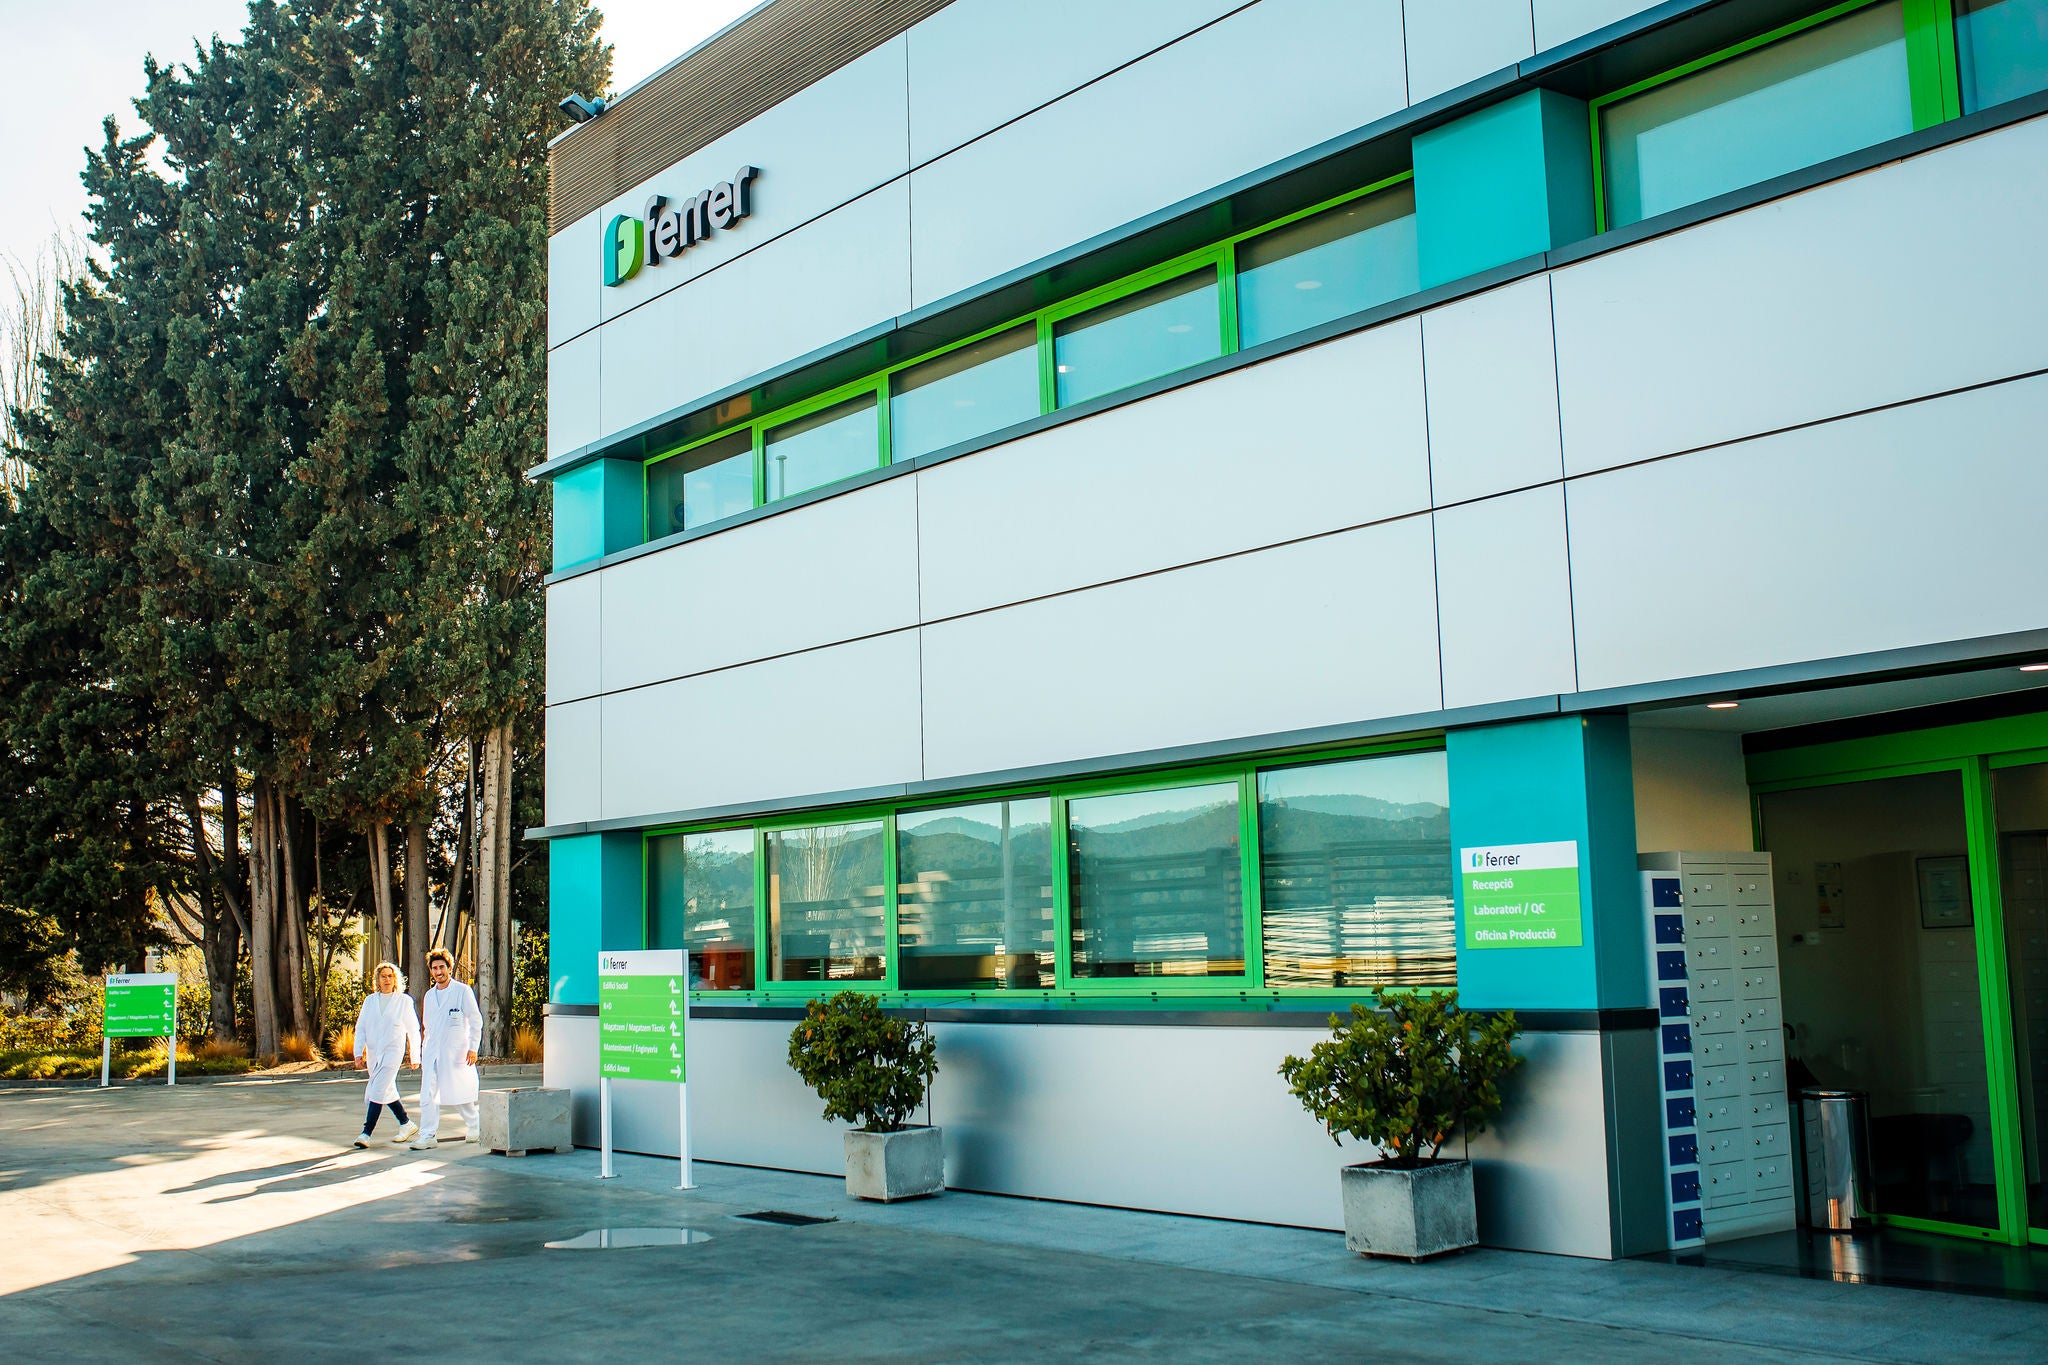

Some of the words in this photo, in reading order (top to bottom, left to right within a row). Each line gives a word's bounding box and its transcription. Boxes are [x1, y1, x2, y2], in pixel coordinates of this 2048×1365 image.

[643, 165, 759, 266] ferrer
[1486, 851, 1520, 866] ferrer
[1472, 877, 1514, 891] Recepció
[1473, 903, 1521, 915] Laboratori
[1523, 902, 1529, 915] /
[1531, 902, 1545, 914] QC
[1475, 929, 1507, 941] Oficina
[1509, 928, 1556, 940] Producció
[610, 957, 628, 970] ferrer
[115, 976, 130, 984] ferrer
